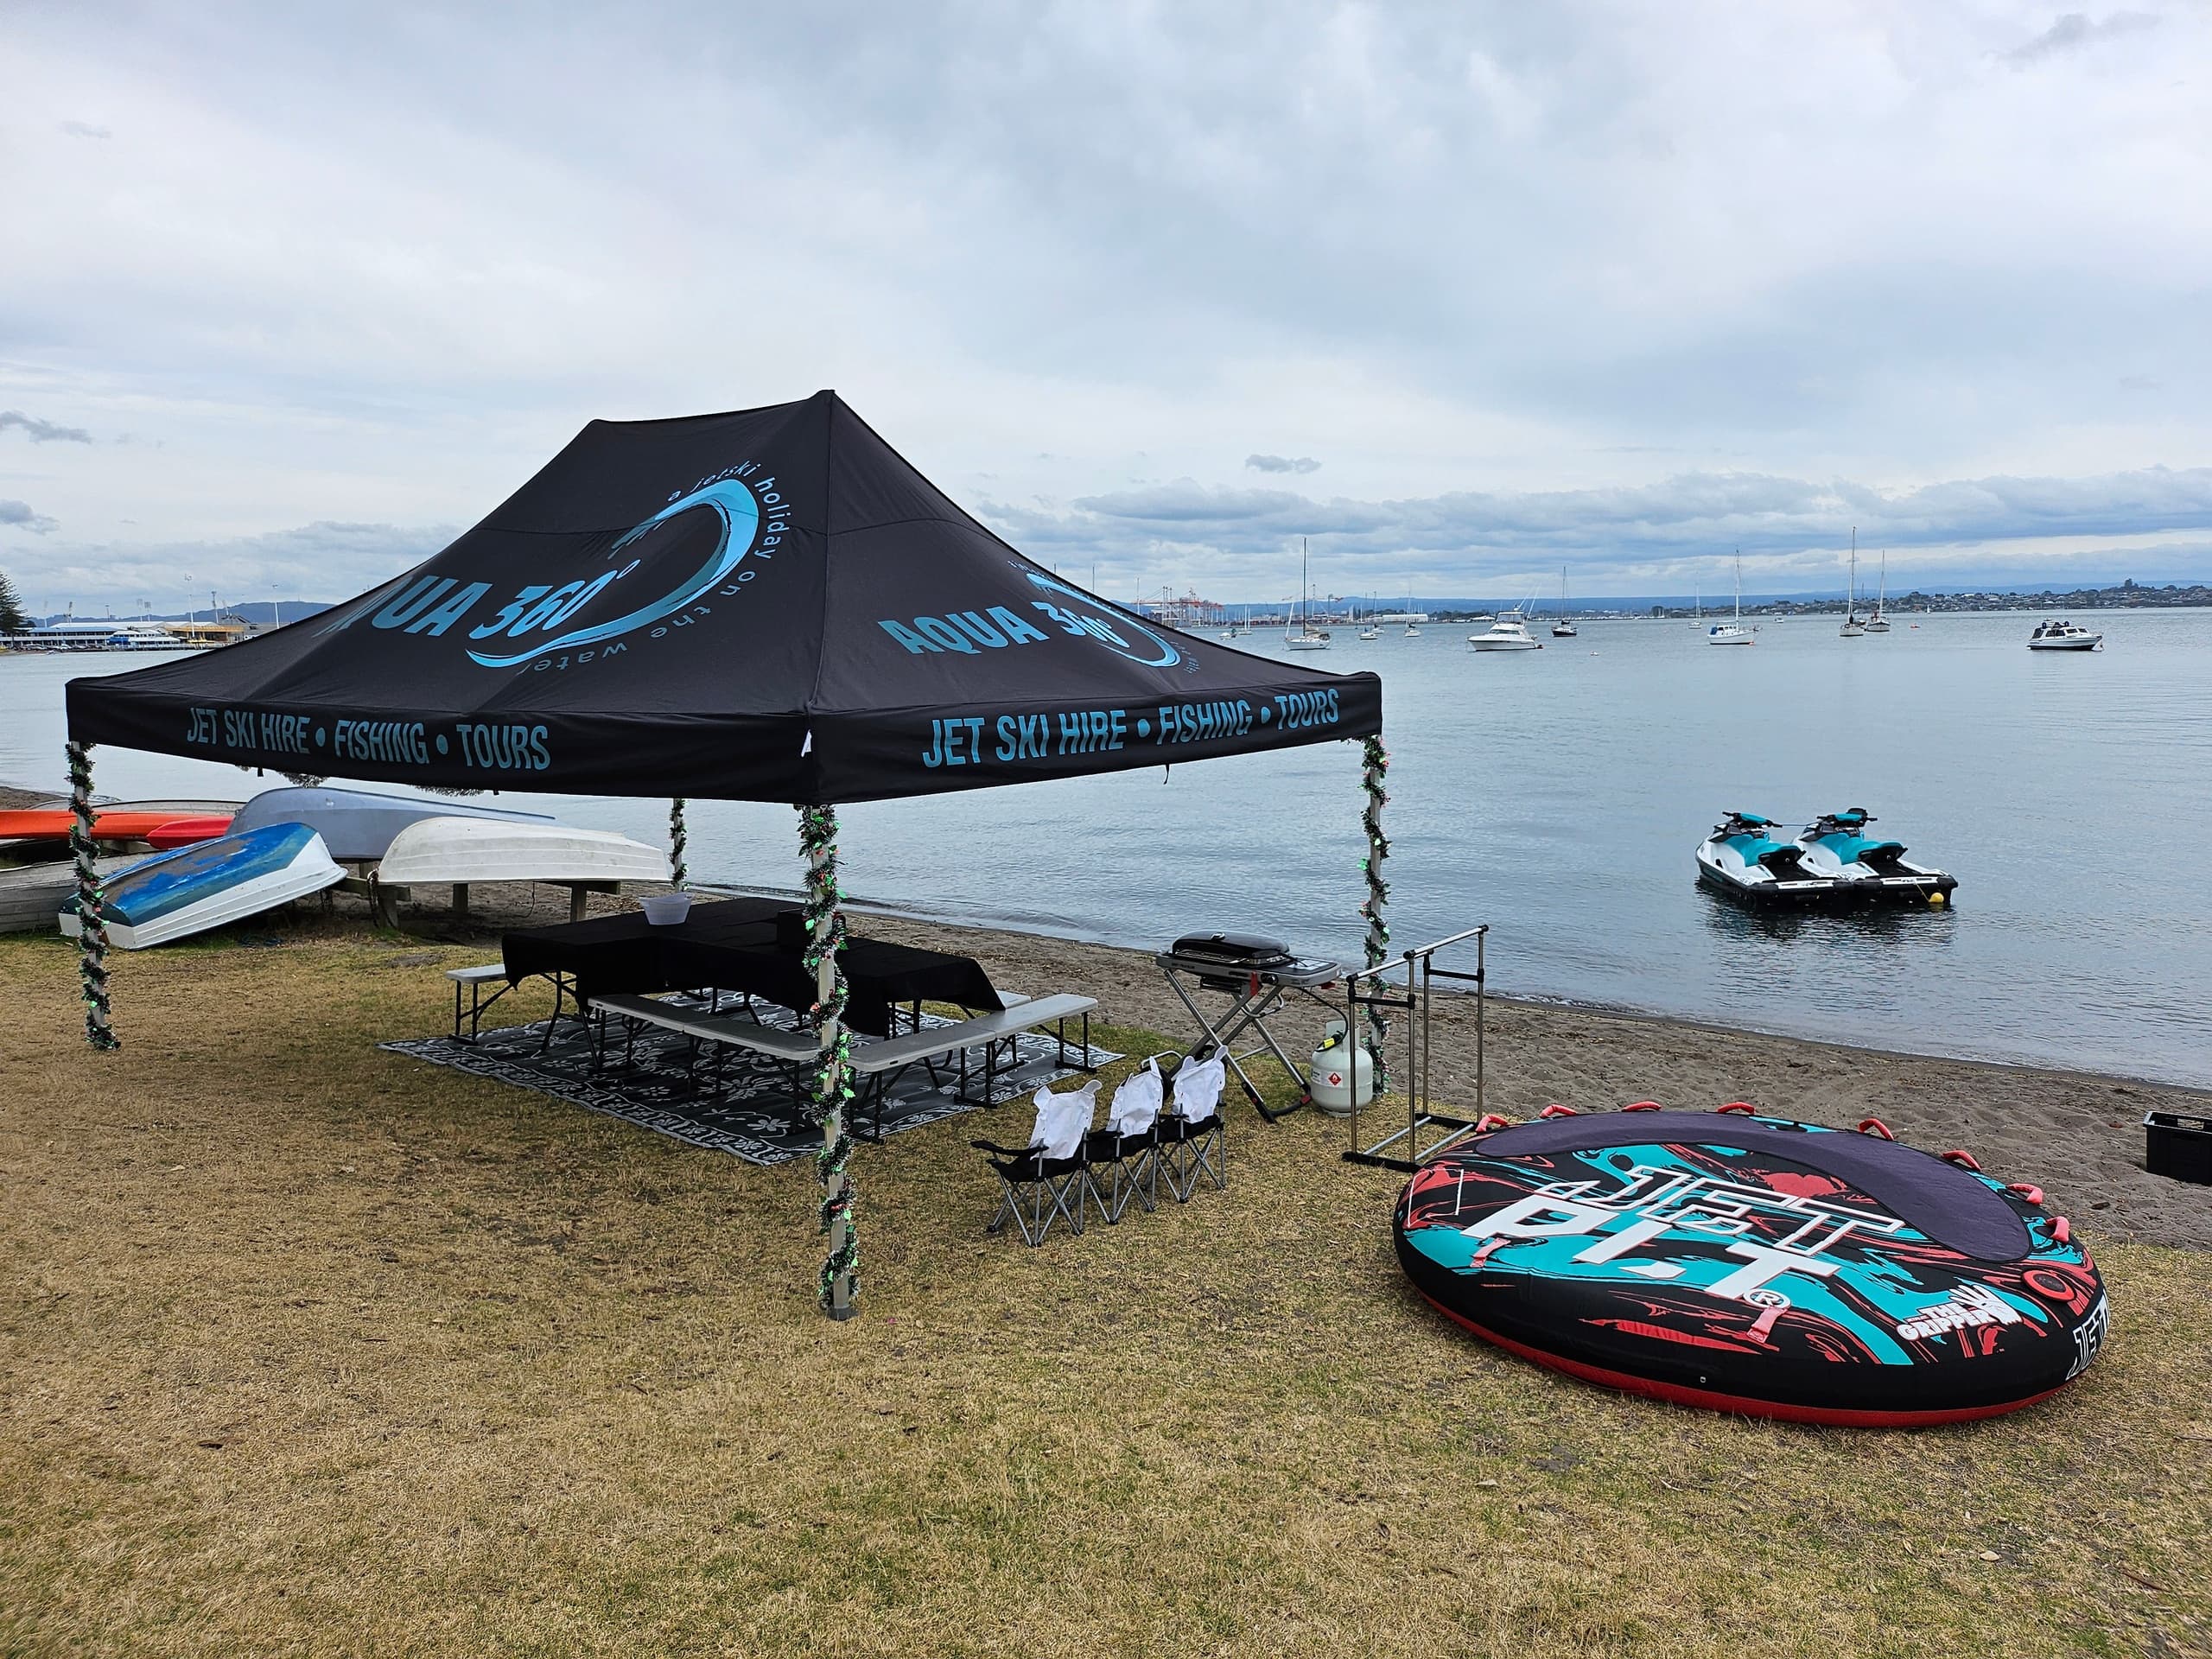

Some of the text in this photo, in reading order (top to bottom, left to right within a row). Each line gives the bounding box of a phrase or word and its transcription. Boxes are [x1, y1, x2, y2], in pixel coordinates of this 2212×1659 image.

[690, 460, 761, 493] jetski
[753, 476, 791, 560] holiday
[719, 570, 756, 596] on
[650, 606, 712, 639] the
[877, 605, 1051, 656] AQUA
[187, 707, 552, 771] JET SKI HIRE FISHING TOURS
[921, 688, 1339, 768] JET SKI HIRE FISHING TOURS
[1533, 1164, 1906, 1257] JET
[1896, 1309, 1999, 1341] GRIPPER
[1917, 1301, 1971, 1319] THE
